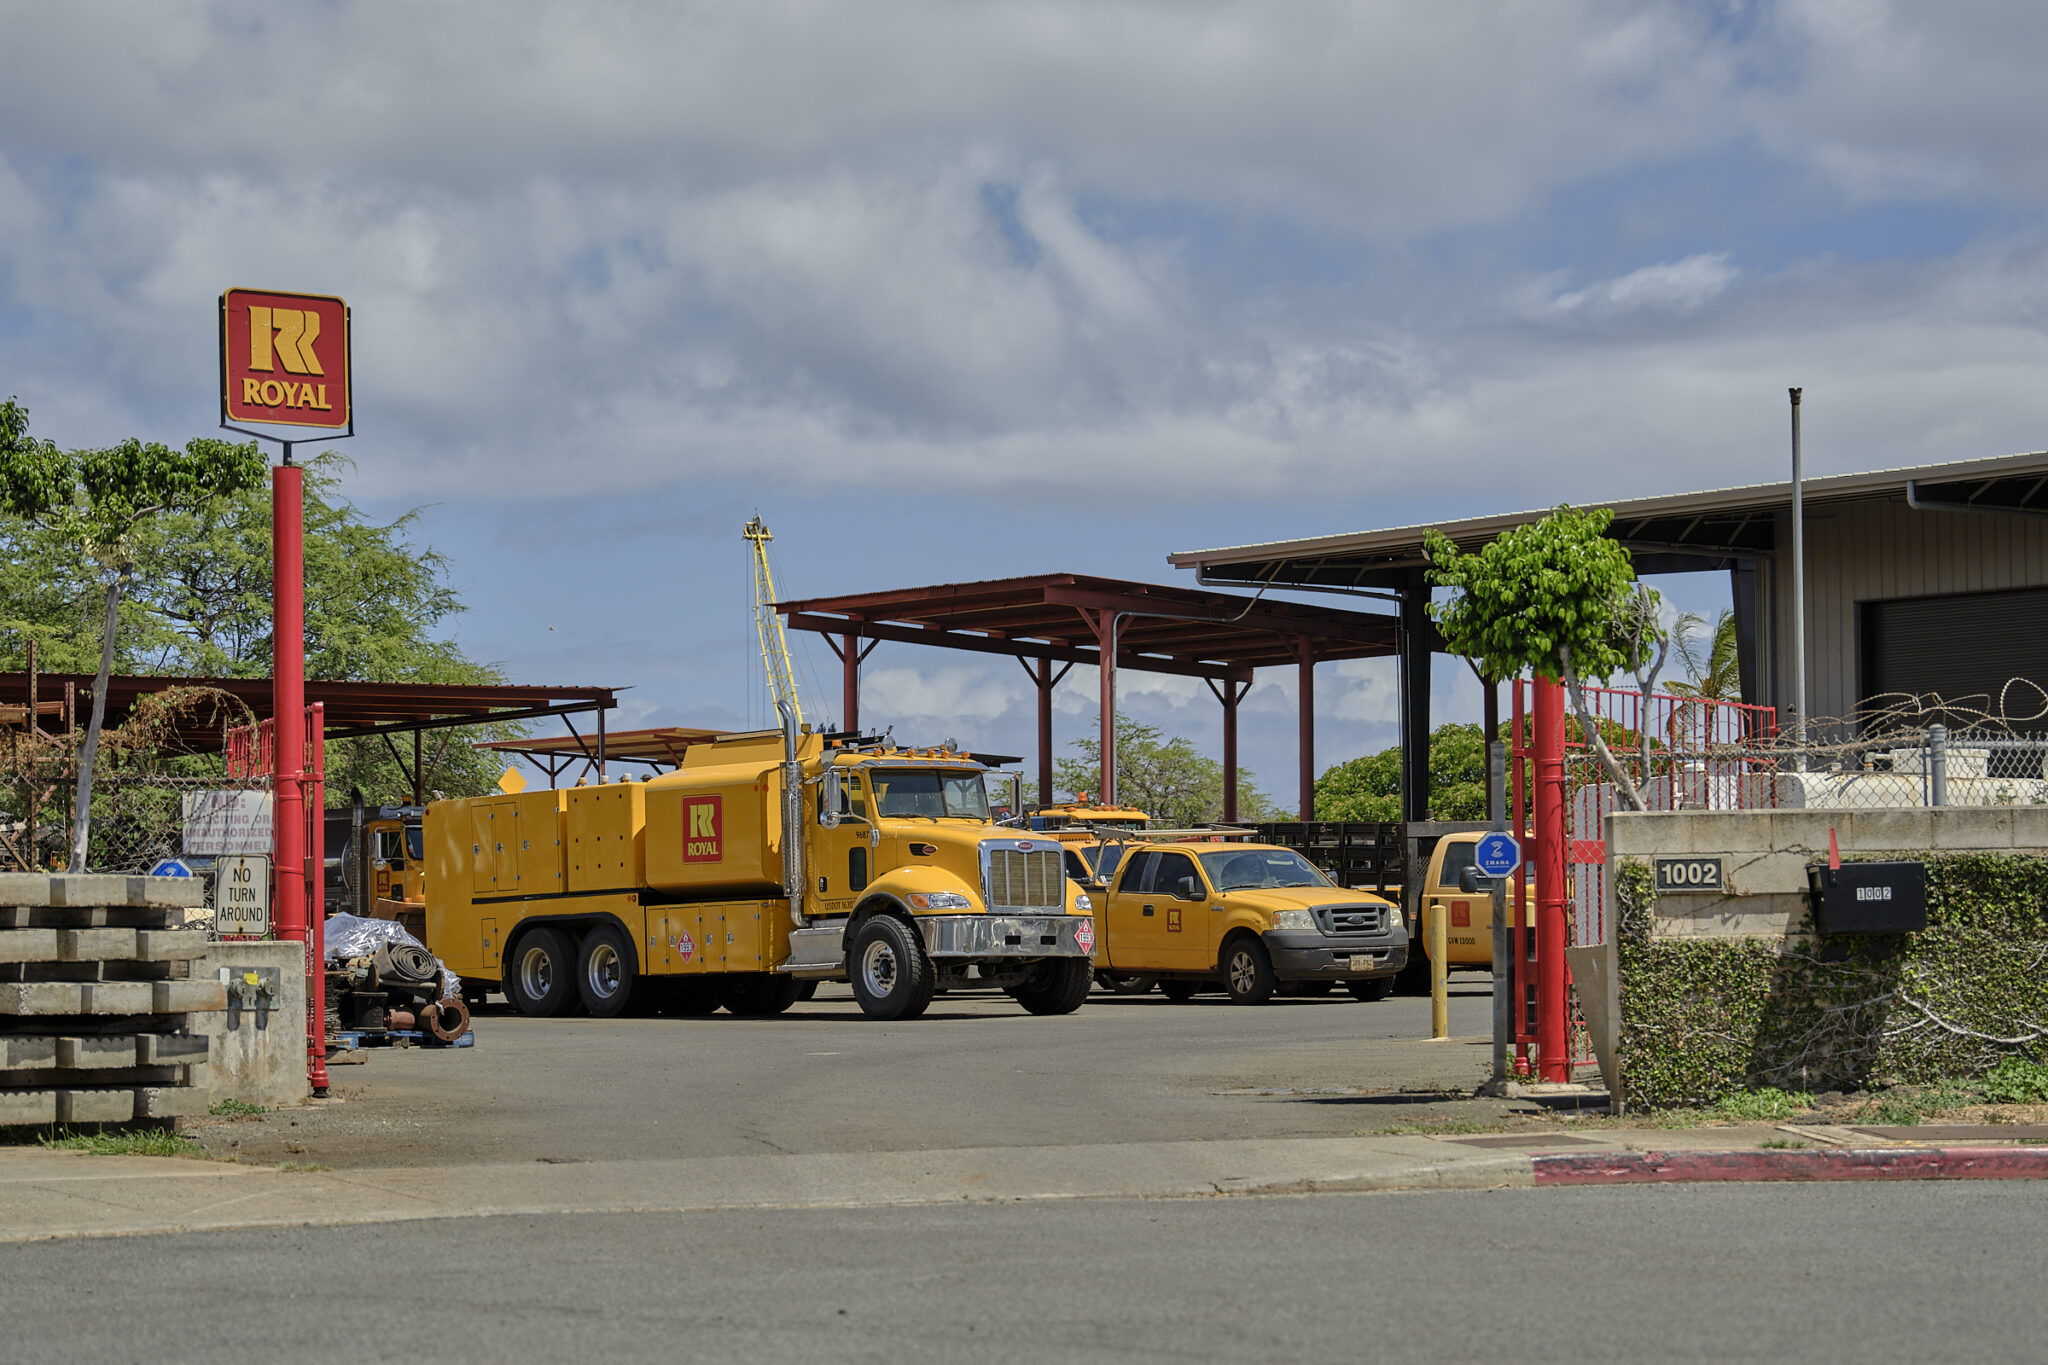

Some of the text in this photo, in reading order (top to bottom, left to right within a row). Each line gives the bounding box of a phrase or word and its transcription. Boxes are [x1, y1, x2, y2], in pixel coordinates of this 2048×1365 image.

[242, 378, 332, 411] ROYAL
[255, 814, 270, 824] OR
[185, 828, 272, 838] UNAUTHORIZED
[856, 831, 869, 839] 9687
[188, 841, 270, 851] PERSONNEL
[687, 841, 719, 856] ROYAL
[233, 867, 251, 883] NO
[1661, 863, 1717, 885] 1002
[228, 888, 256, 903] TURN
[1856, 887, 1892, 900] 1002
[824, 901, 840, 911] USDOT
[219, 907, 264, 922] AROUND
